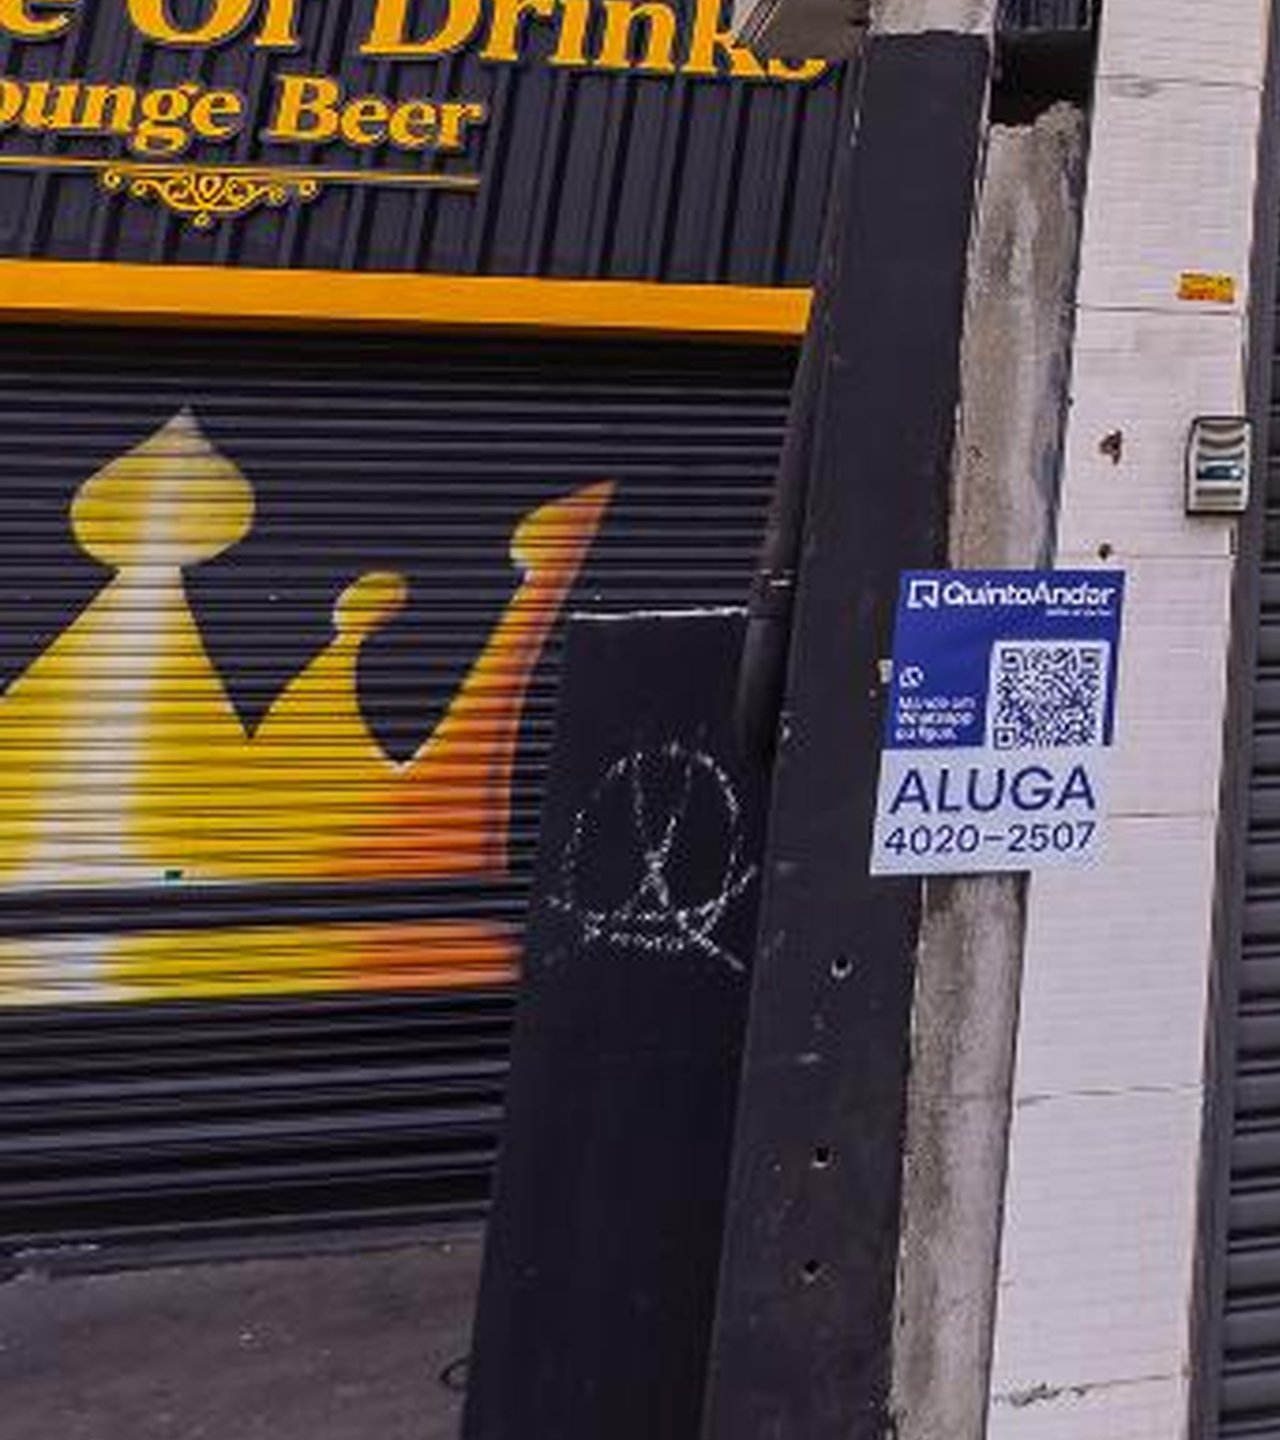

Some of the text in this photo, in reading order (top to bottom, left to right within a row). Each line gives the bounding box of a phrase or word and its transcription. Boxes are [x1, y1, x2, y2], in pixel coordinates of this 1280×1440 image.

[269, 74, 482, 150] Beer
[942, 579, 1117, 607] QuintoAndar
[889, 765, 1097, 815] ALUGA
[884, 821, 1097, 856] 4020-2507
